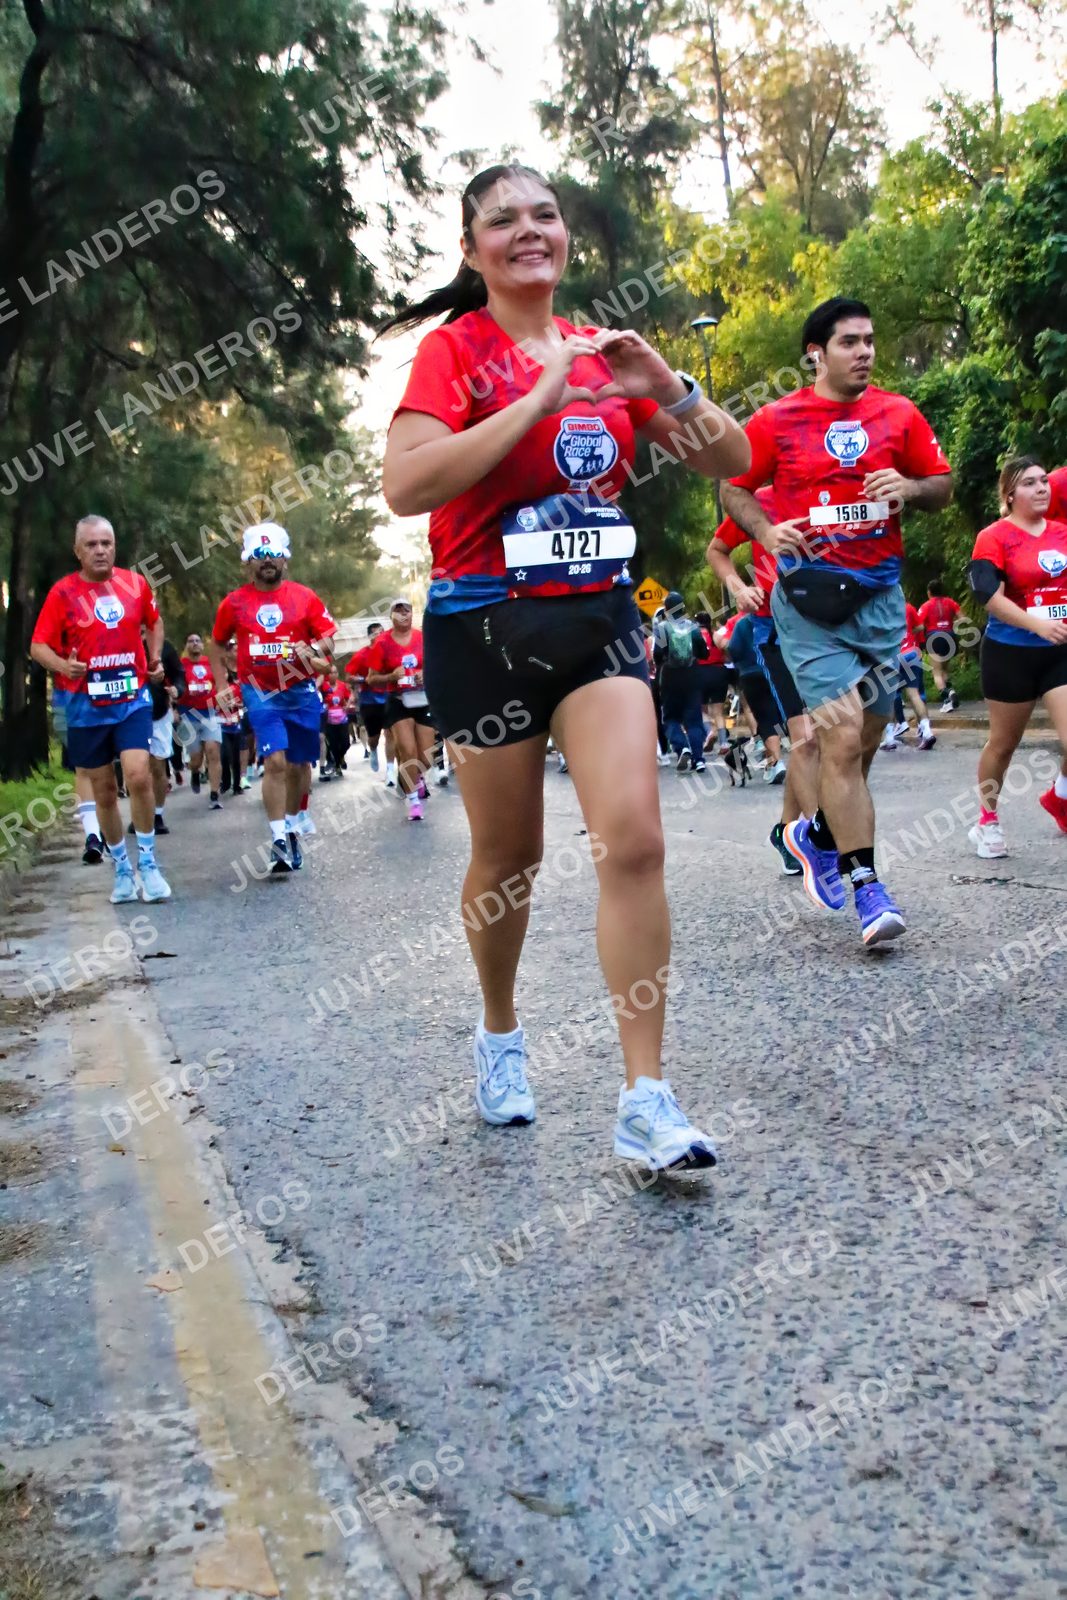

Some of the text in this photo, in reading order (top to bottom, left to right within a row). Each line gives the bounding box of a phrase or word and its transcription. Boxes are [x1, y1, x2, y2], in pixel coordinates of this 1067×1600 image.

[567, 423, 600, 432] BIMBO
[570, 435, 602, 448] Global
[563, 445, 592, 458] Race
[836, 504, 868, 522] 1568
[260, 535, 271, 546] B
[551, 529, 601, 560] 4727
[568, 564, 592, 576] 20-26
[261, 644, 282, 654] 2402
[88, 652, 136, 669] SANTIAGO
[104, 680, 125, 694] 4134
